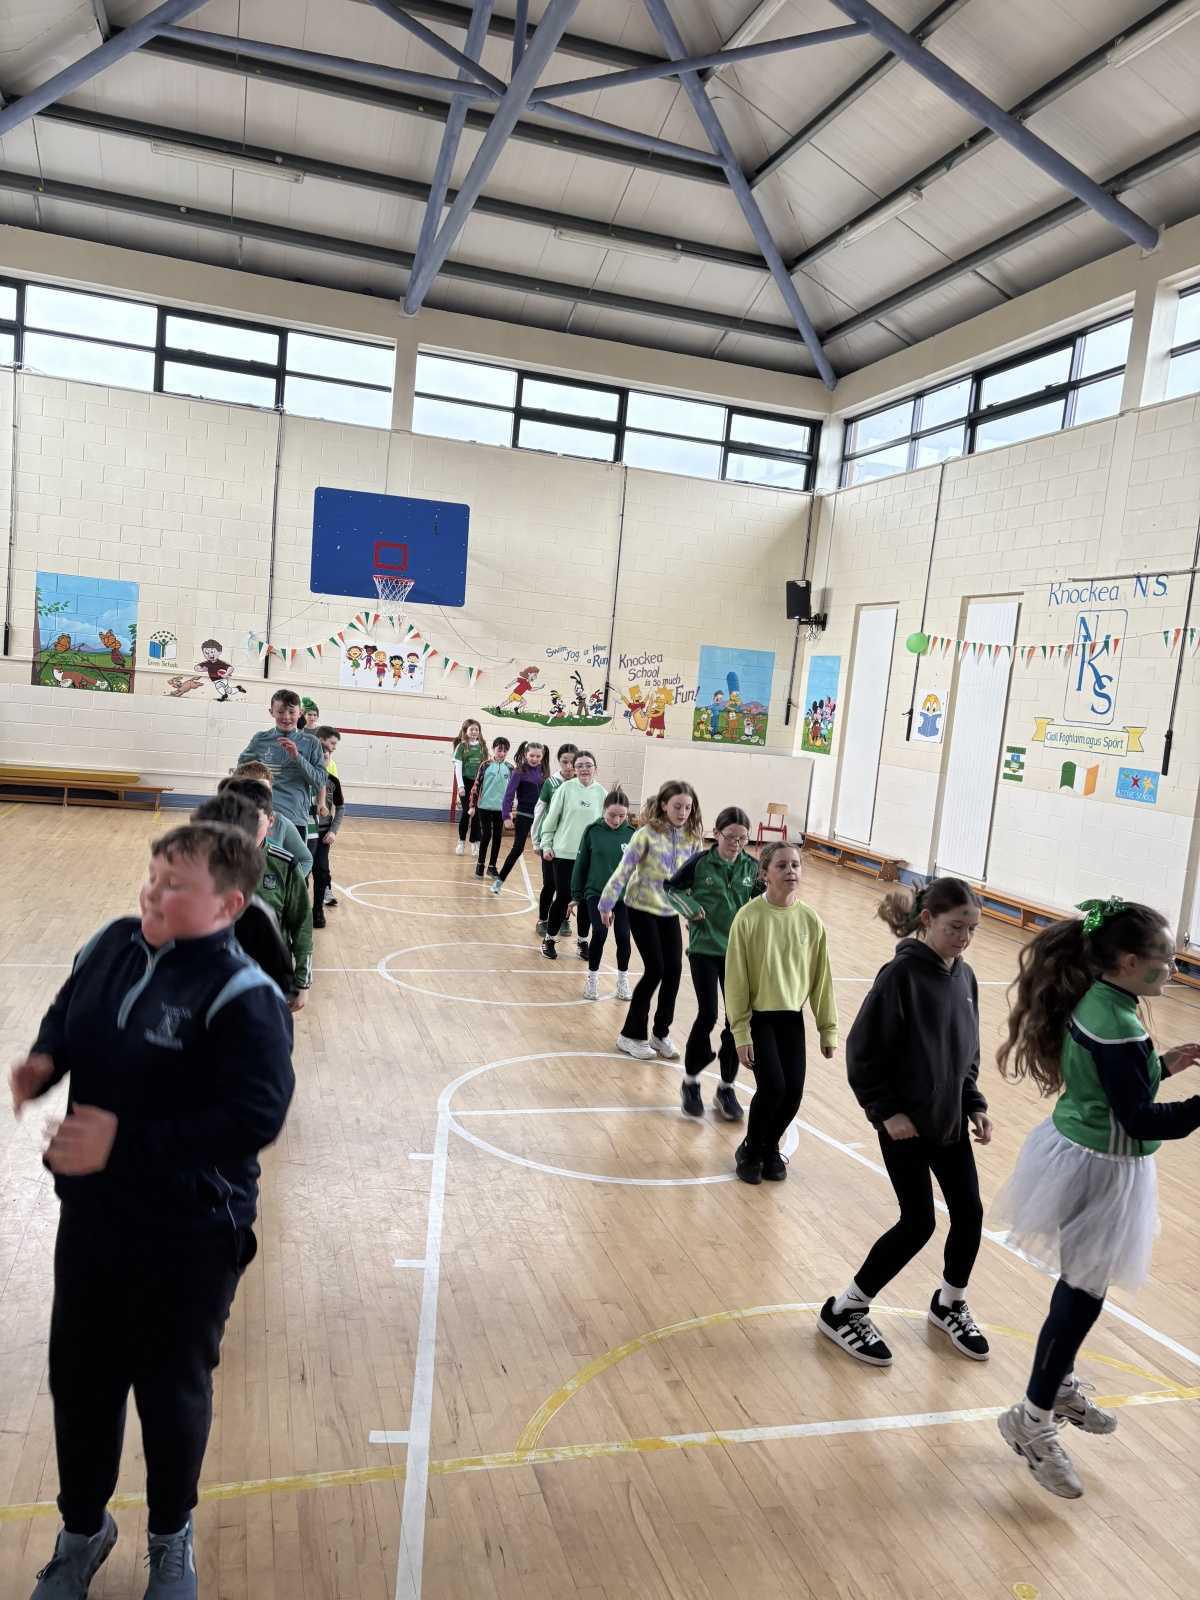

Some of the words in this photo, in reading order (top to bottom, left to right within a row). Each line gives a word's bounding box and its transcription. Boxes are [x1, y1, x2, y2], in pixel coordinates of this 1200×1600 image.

[1048, 579, 1120, 606] Knockea
[591, 654, 609, 668] Run
[618, 651, 663, 670] Knockea
[628, 666, 660, 682] School
[662, 673, 681, 688] much
[673, 685, 701, 705] Fun!
